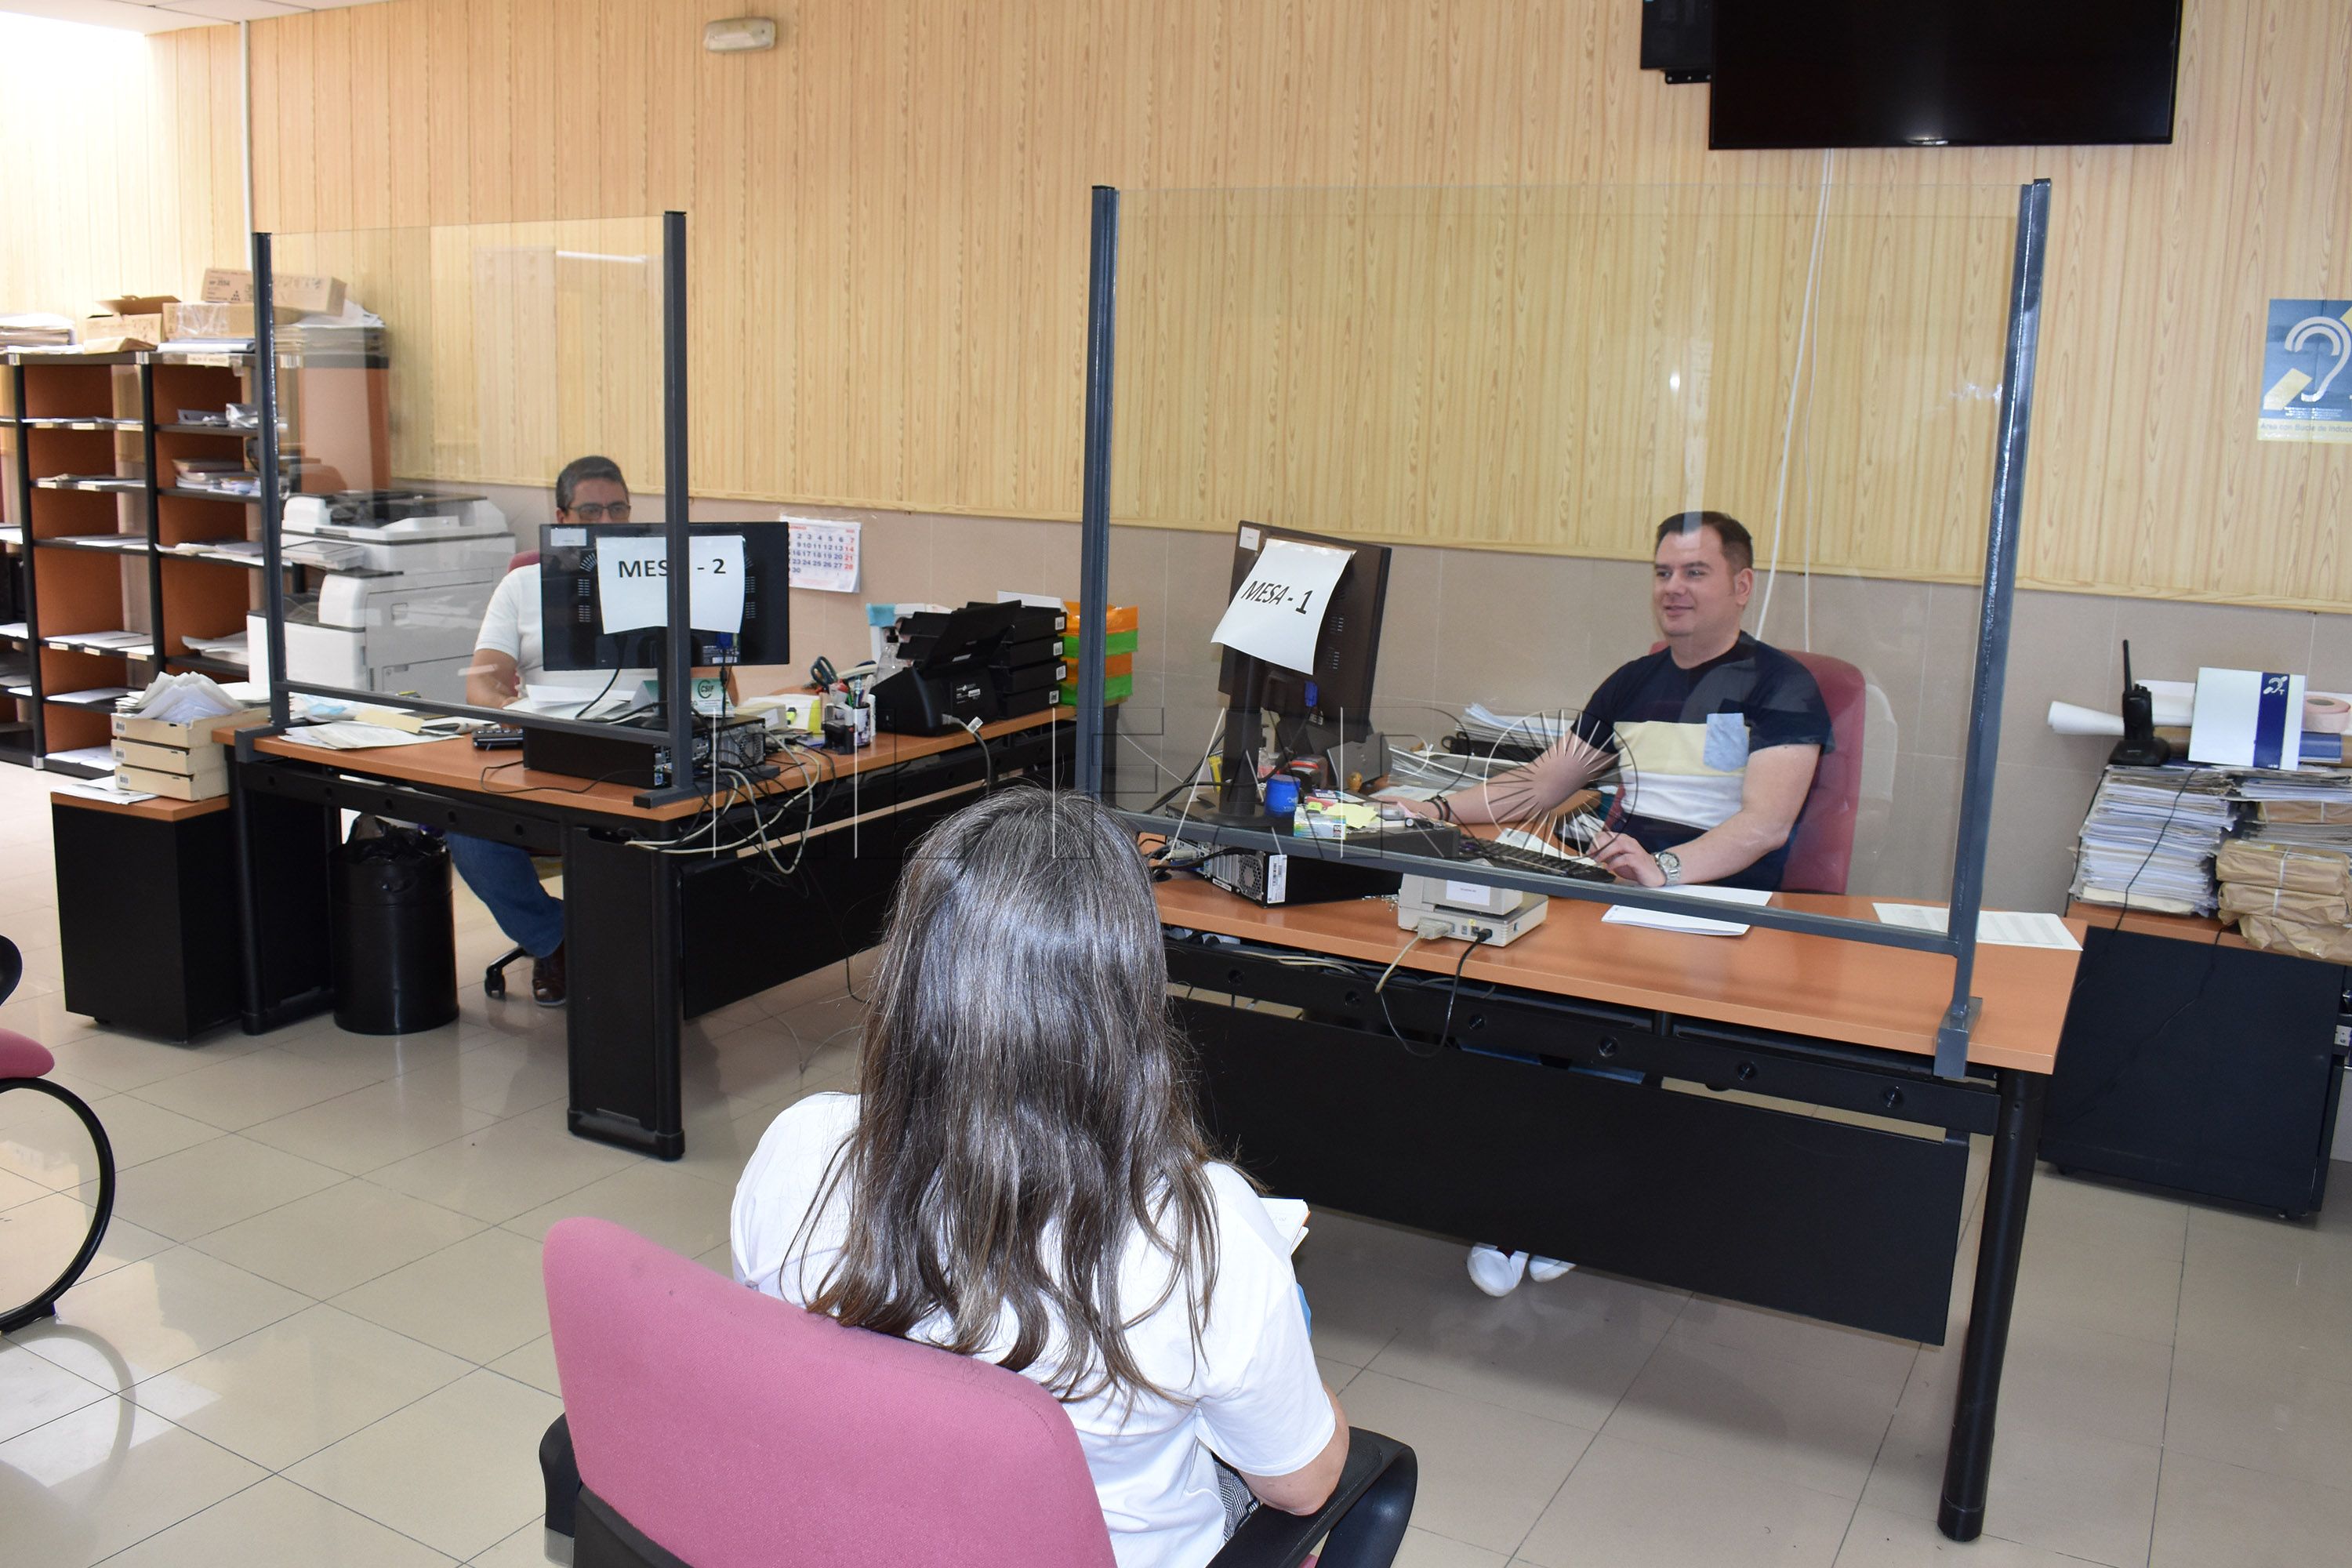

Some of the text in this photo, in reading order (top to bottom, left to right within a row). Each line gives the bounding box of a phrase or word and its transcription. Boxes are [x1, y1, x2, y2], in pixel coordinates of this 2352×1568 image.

[618, 559, 668, 578] MES
[712, 558, 726, 575] 2
[1240, 580, 1290, 605] MESA
[1295, 590, 1313, 615] 1
